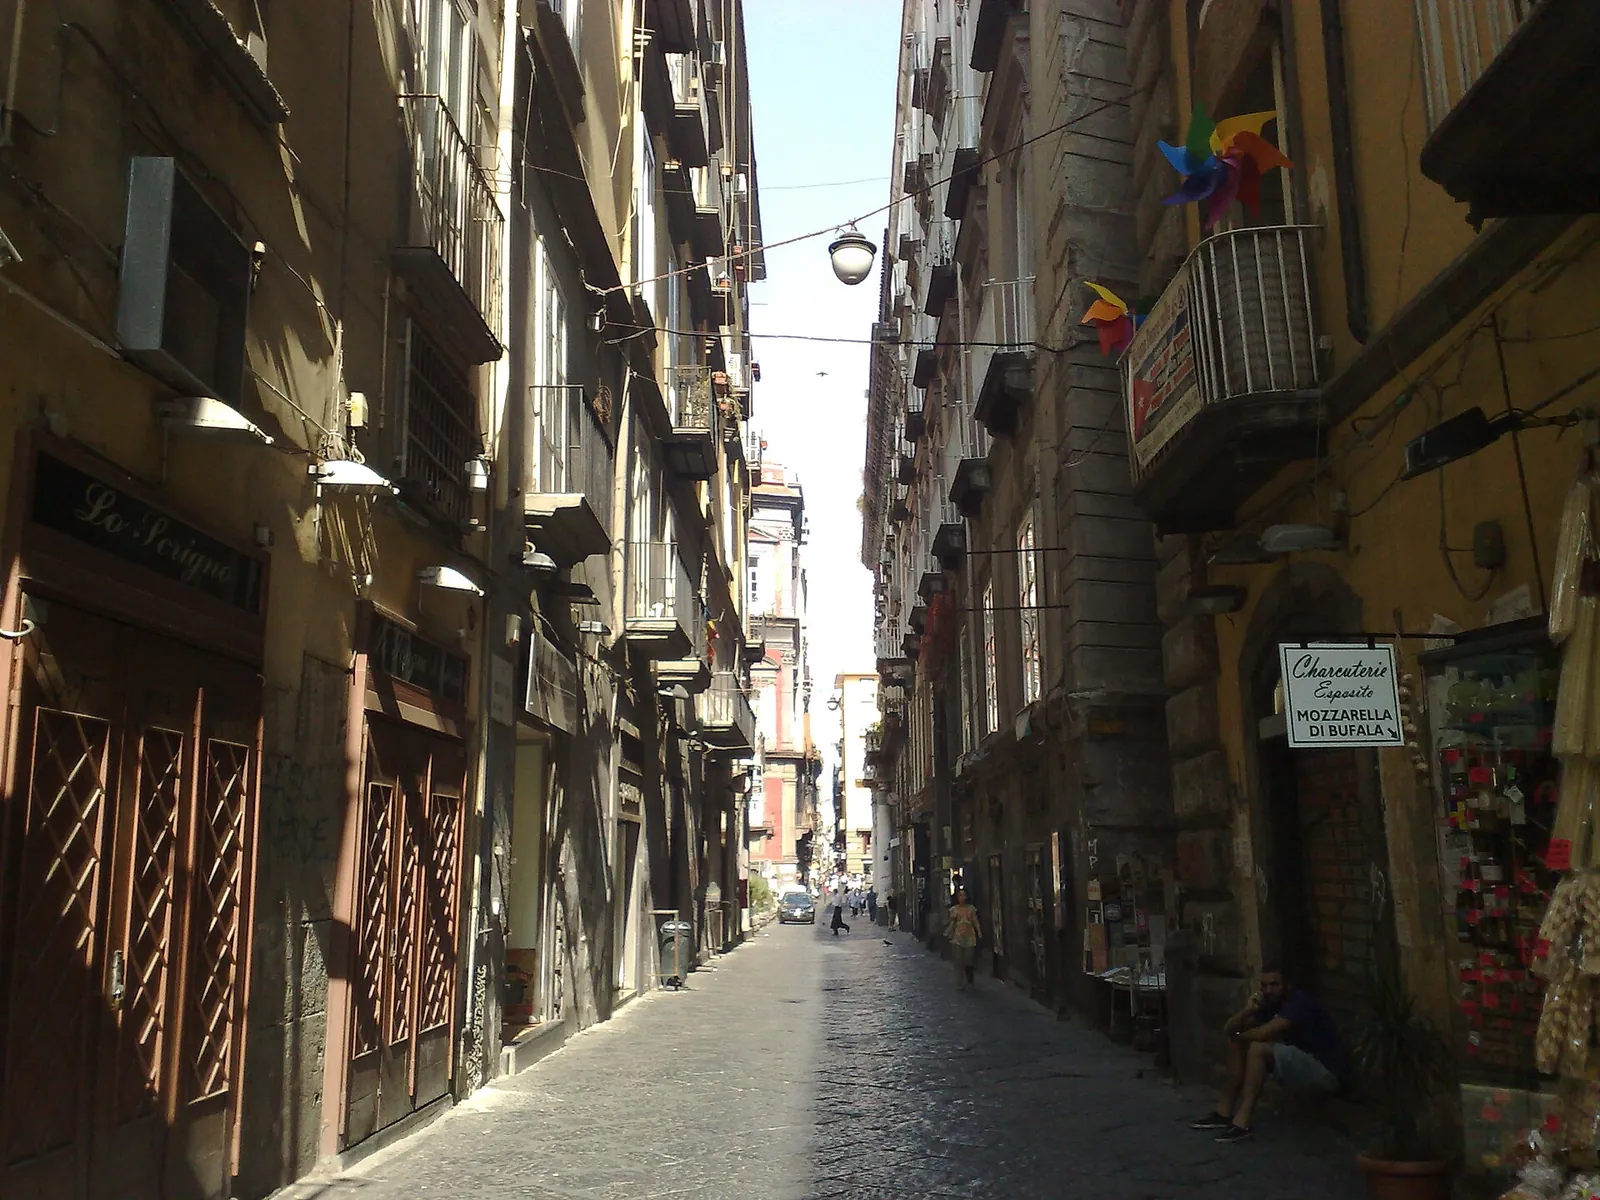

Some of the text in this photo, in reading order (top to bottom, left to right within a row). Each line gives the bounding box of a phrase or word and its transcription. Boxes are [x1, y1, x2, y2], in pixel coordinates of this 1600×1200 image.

[75, 483, 231, 584] Lo Scrigno
[1292, 654, 1388, 679] Charcuterie
[1313, 680, 1374, 704] Esposito
[1297, 709, 1393, 722] MOZZARELLA
[1309, 724, 1384, 737] DI BUFALA
